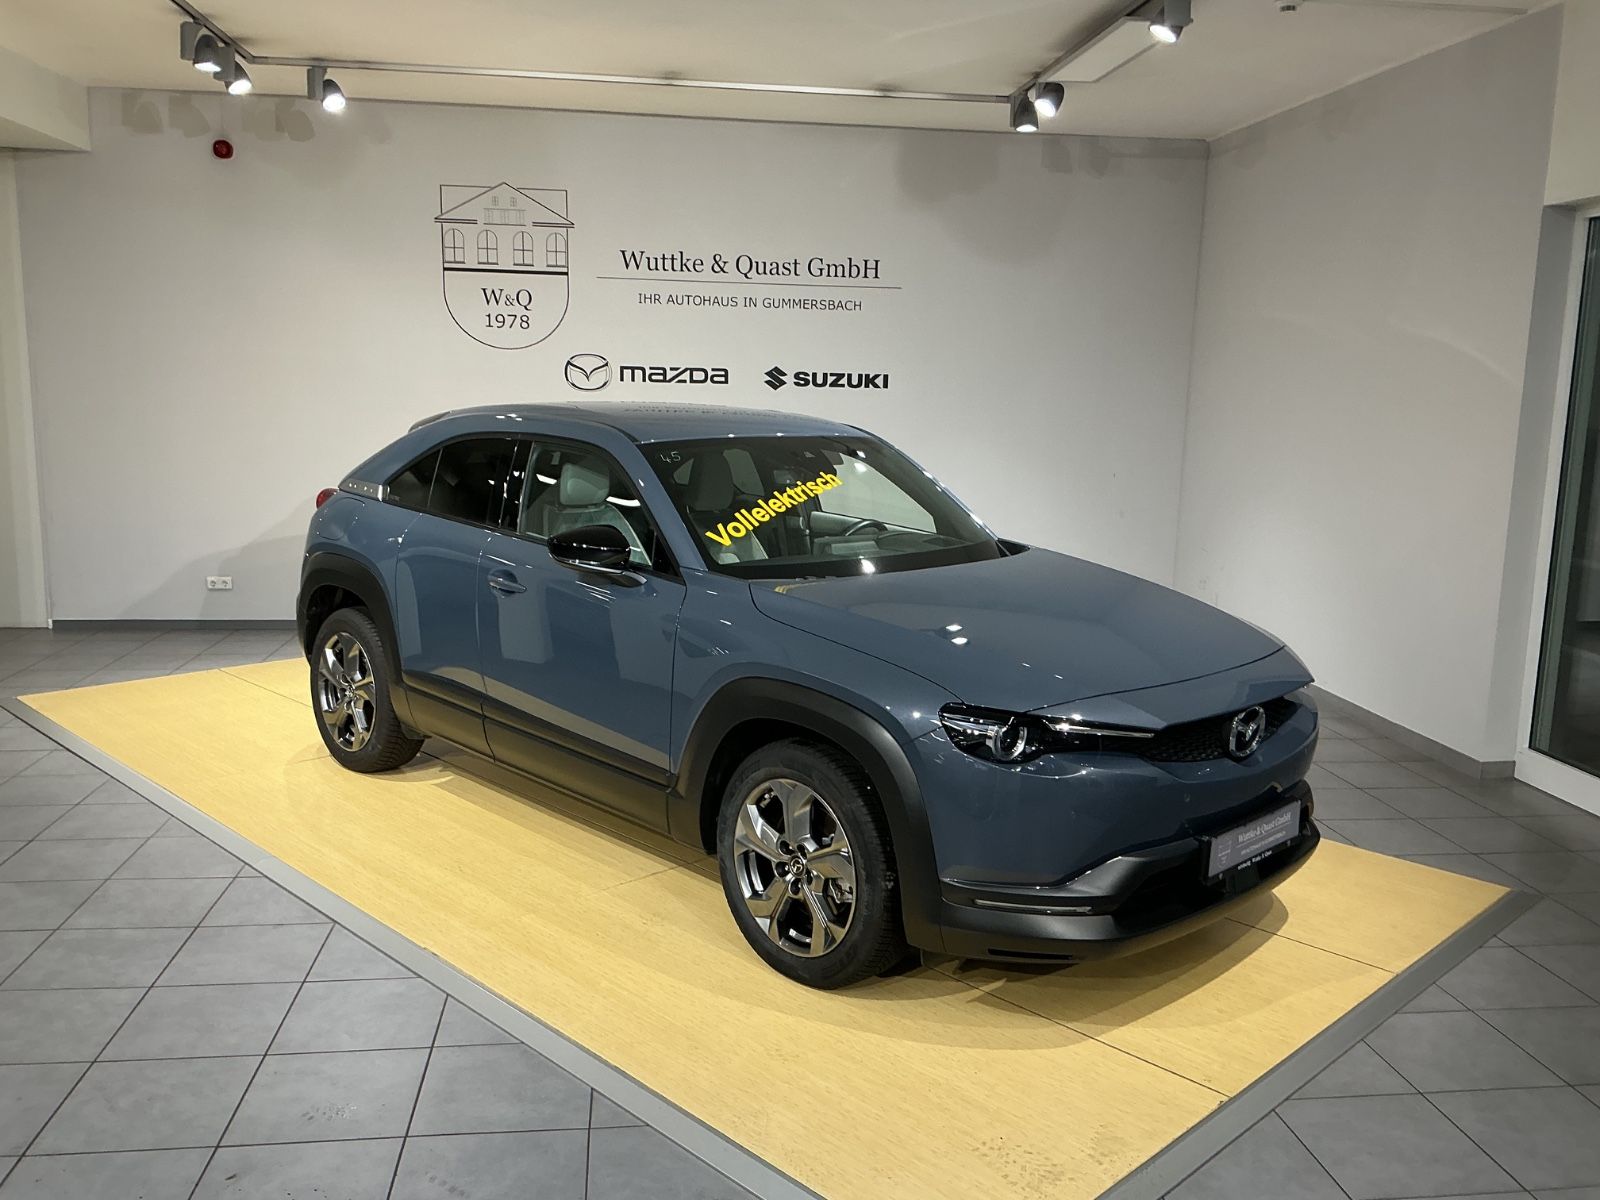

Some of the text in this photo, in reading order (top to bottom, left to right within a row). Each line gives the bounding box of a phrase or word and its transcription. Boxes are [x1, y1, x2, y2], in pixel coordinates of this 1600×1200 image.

[619, 249, 881, 280] Wuttke & Quast GmbH
[481, 287, 534, 312] W&Q
[638, 292, 862, 312] IHR AUTOHAUS IN GUMMERSBACH
[484, 313, 530, 331] 1978
[793, 371, 889, 390] SUZUKI
[660, 451, 681, 463] 45
[705, 472, 842, 546] Vollelektrisch
